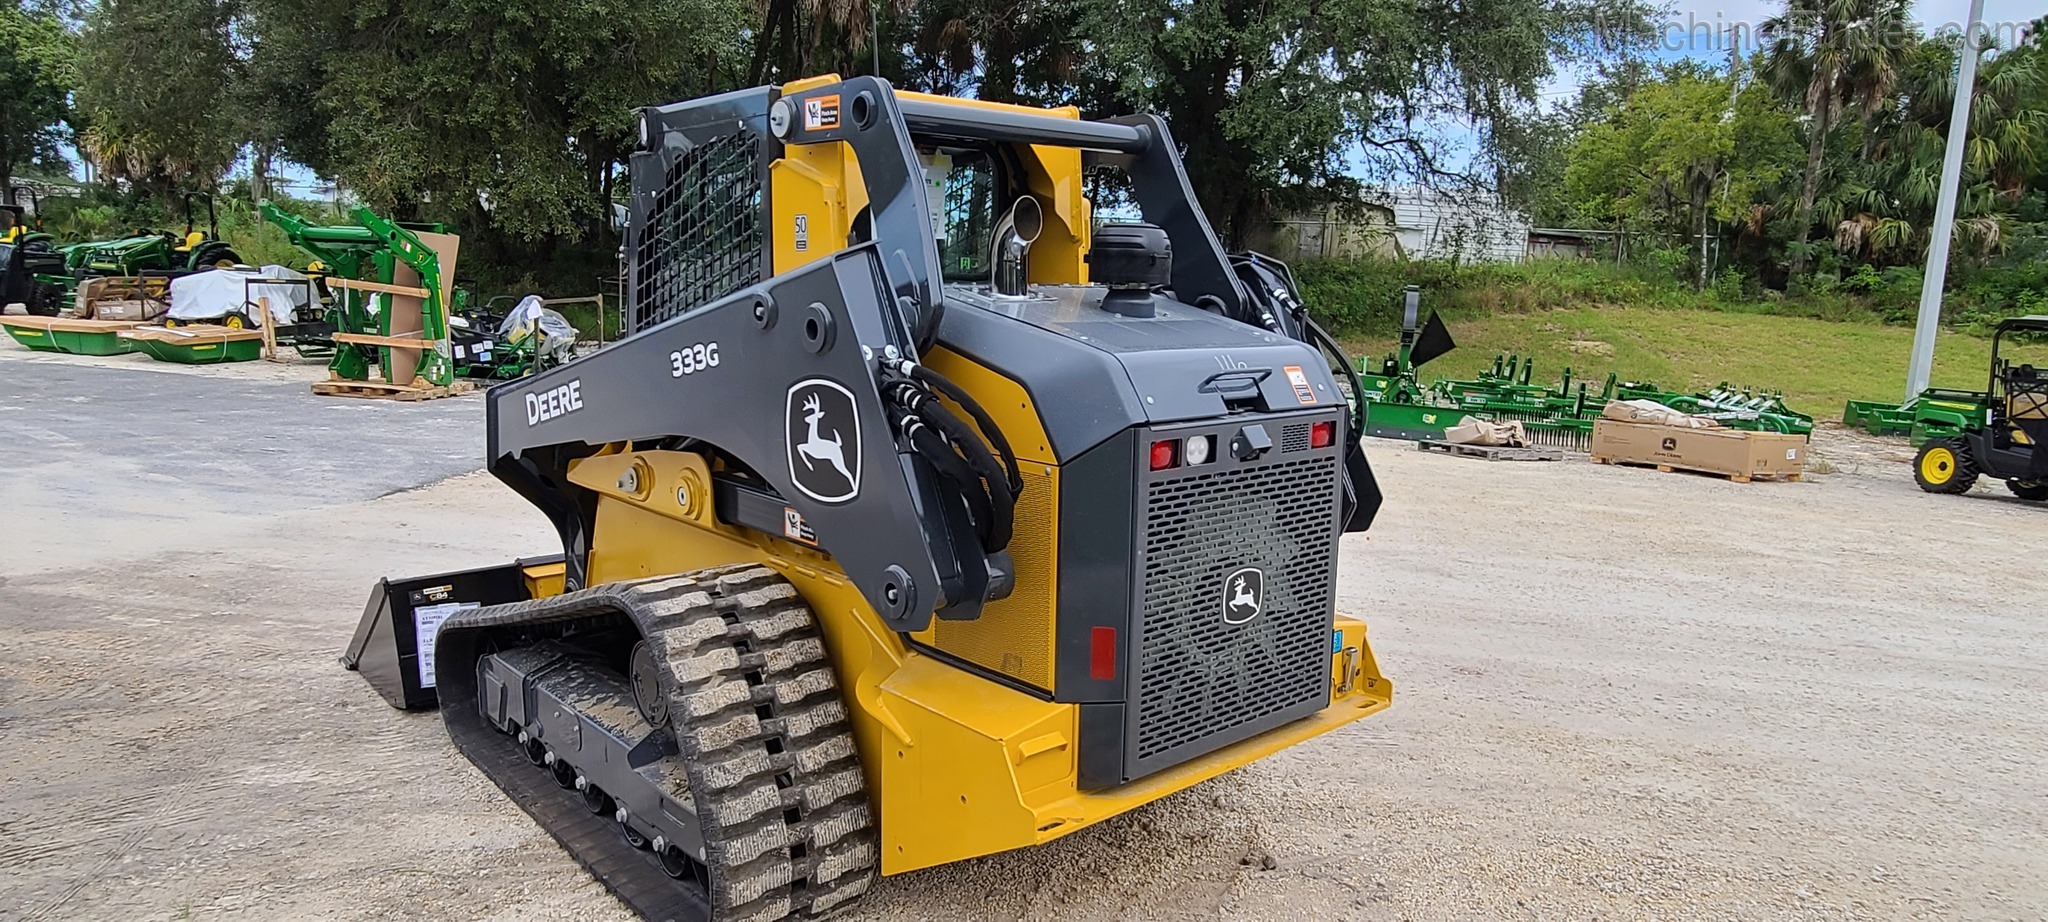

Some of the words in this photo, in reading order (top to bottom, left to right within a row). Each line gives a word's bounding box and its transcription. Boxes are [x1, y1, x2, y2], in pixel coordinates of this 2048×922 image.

[795, 216, 807, 234] 50
[670, 342, 720, 378] 333G
[525, 379, 584, 426] DEERE
